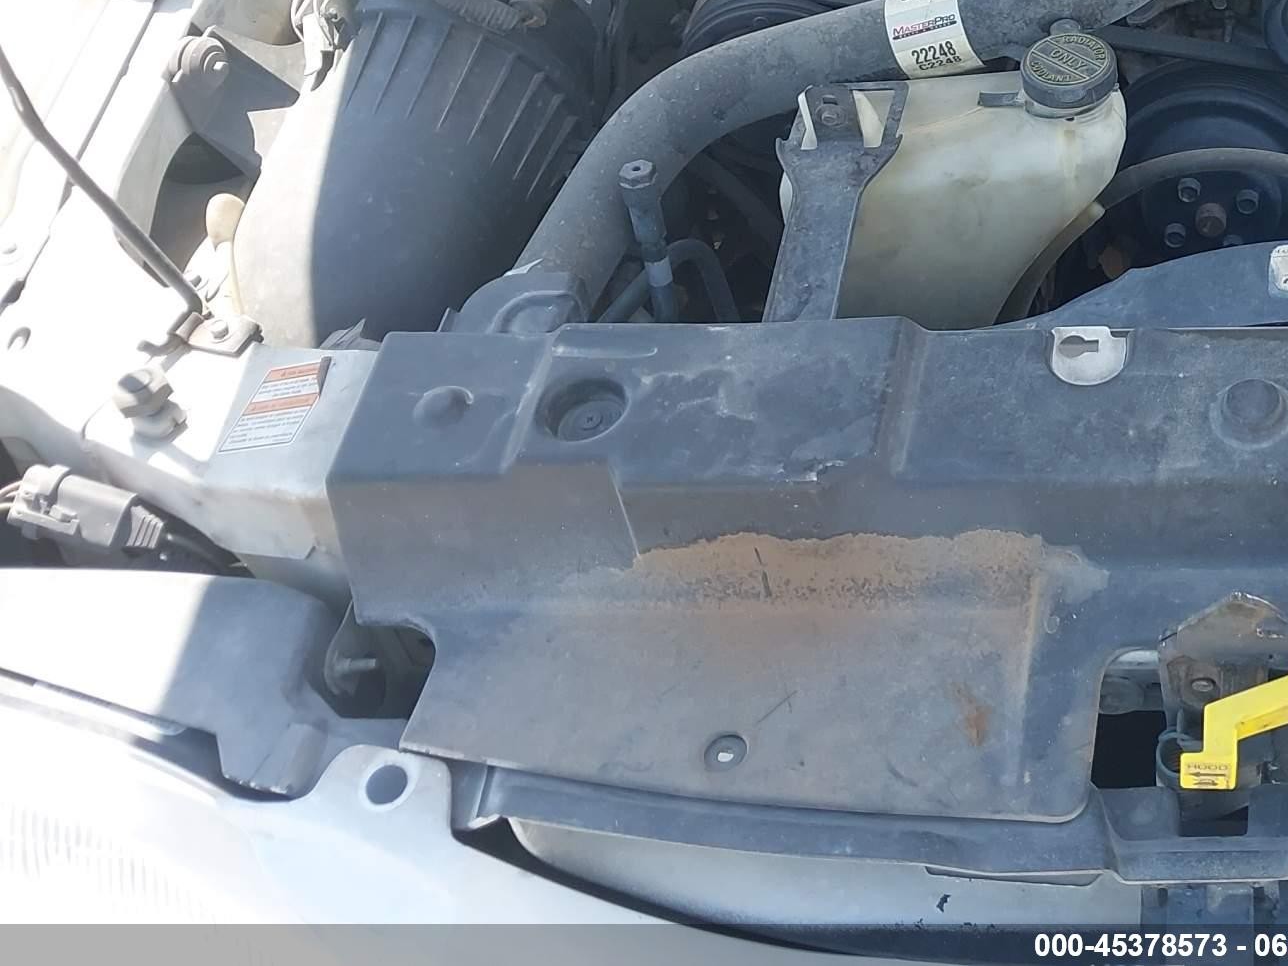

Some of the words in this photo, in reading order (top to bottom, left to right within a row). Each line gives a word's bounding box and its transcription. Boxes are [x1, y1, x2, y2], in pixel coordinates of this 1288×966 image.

[911, 40, 957, 65] 22248
[1049, 48, 1087, 71] ONLY
[1061, 35, 1105, 61] RADIATOR
[918, 55, 962, 71] C2248
[1029, 61, 1072, 83] COOLANT
